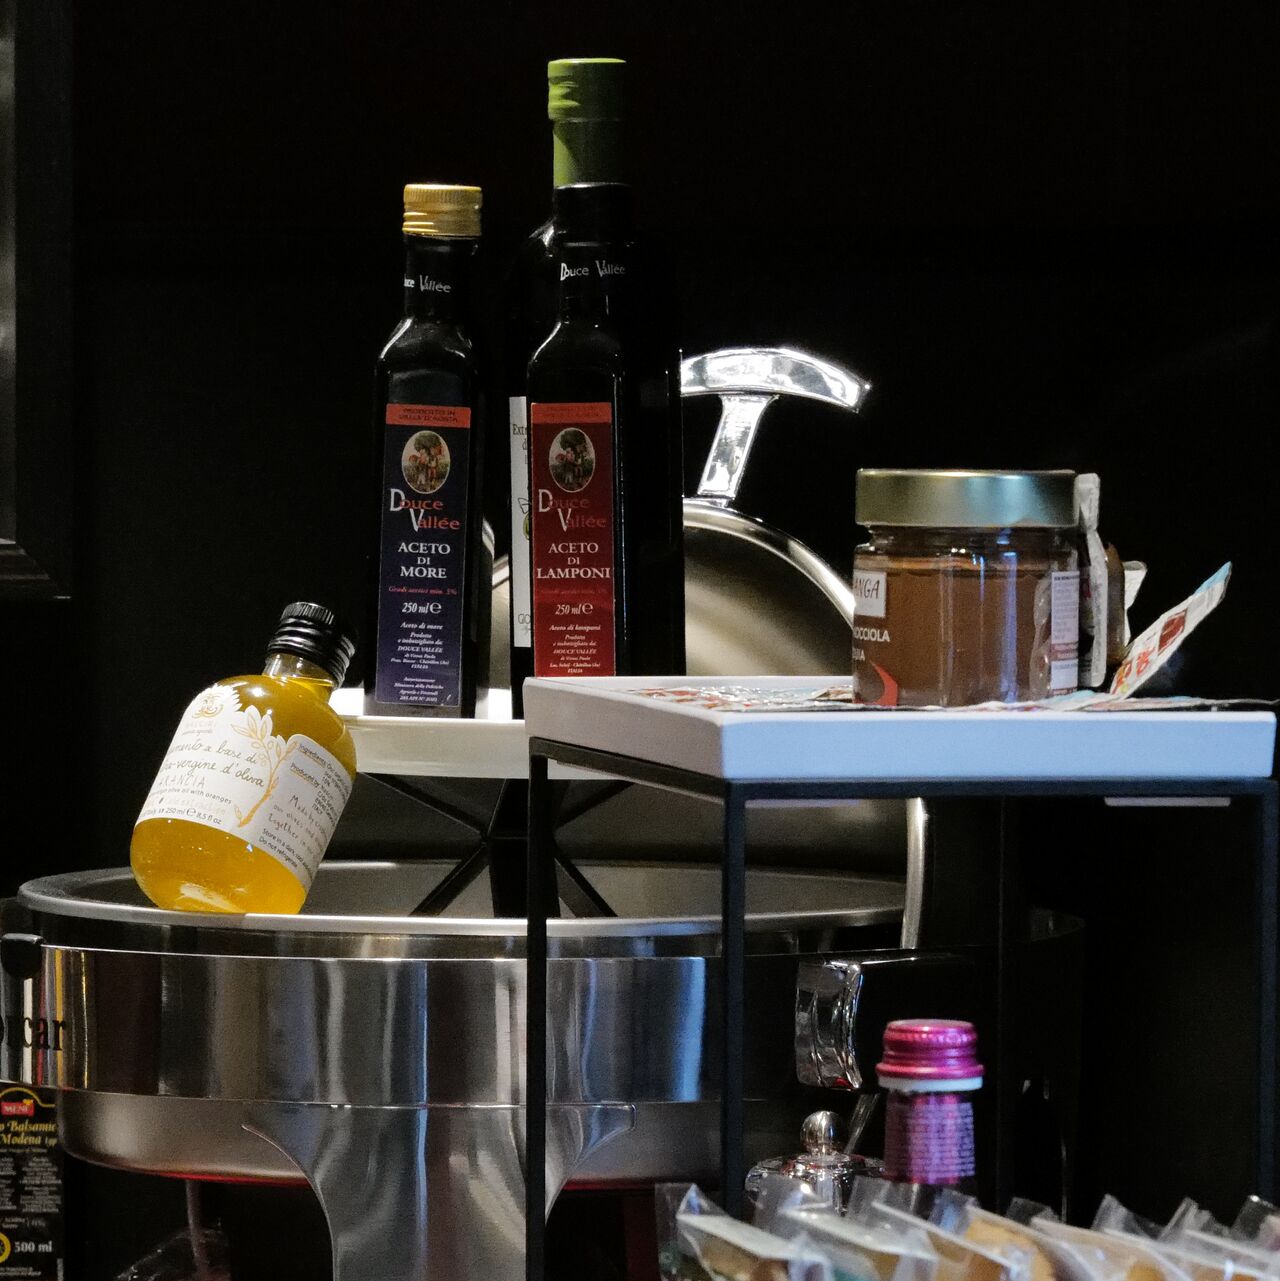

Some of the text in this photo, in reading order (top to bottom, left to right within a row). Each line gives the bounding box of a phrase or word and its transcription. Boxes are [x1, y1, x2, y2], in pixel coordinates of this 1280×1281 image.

[560, 261, 590, 281] Douce
[390, 488, 444, 512] Douce
[538, 488, 592, 513] Douce
[409, 508, 460, 533] Vallée
[557, 507, 608, 533] Vallée
[398, 541, 451, 555] ACETO
[548, 542, 599, 554] ACETO
[417, 556, 431, 566] DI
[567, 556, 581, 566] DI
[400, 565, 447, 579] MORE
[536, 566, 611, 579] LAMPONI
[402, 602, 418, 613] 250
[418, 602, 429, 615] ml
[555, 603, 571, 616] 250
[571, 603, 581, 616] ml
[419, 622, 426, 630] di
[216, 740, 241, 759] base
[221, 763, 265, 788] d'oliva
[204, 793, 232, 805] oranges
[261, 828, 277, 840] Store
[258, 835, 268, 845] Do
[268, 842, 277, 852] not
[7, 1119, 57, 1133] Balsamic
[14, 1239, 53, 1253] 500 ml
